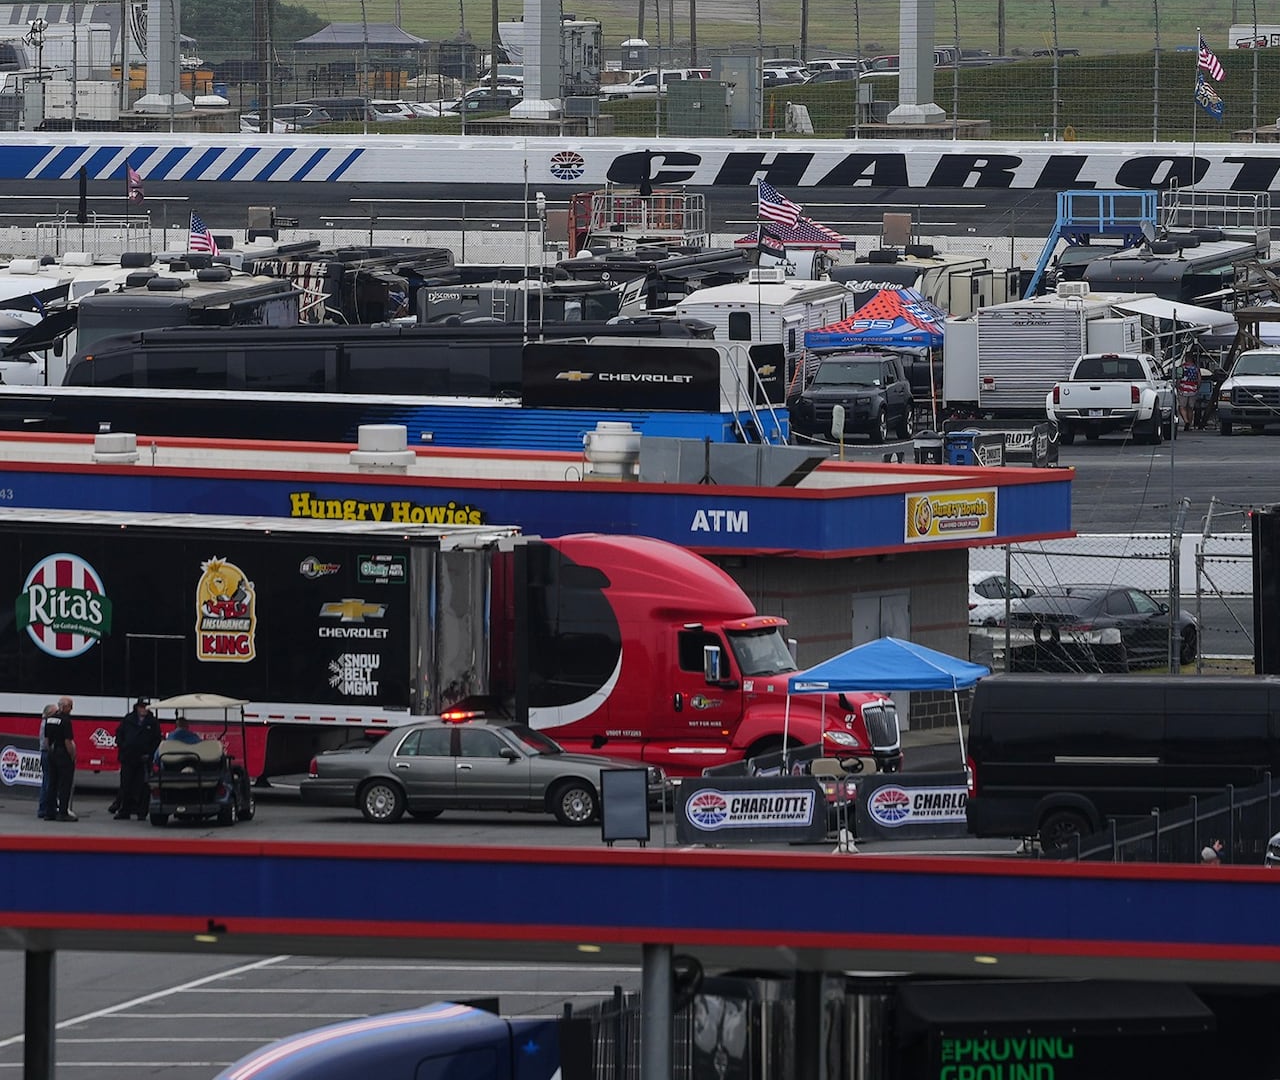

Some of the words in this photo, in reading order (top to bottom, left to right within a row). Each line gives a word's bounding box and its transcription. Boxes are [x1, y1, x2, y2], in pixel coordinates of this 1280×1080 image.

[845, 280, 904, 293] Reflection
[598, 373, 694, 383] CHEVROLET
[289, 492, 385, 522] Hungry
[391, 500, 482, 526] Howie's
[690, 509, 749, 533] ATM
[29, 584, 103, 625] Rita's
[201, 618, 251, 631] INSURANCE
[319, 627, 389, 639] CHEVROLET
[202, 634, 249, 655] KING
[345, 654, 380, 669] SNOW
[345, 668, 371, 682] BELT
[344, 681, 379, 696] MGMT
[730, 797, 808, 813] CHARLOTTE
[955, 1037, 1074, 1062] PROVING
